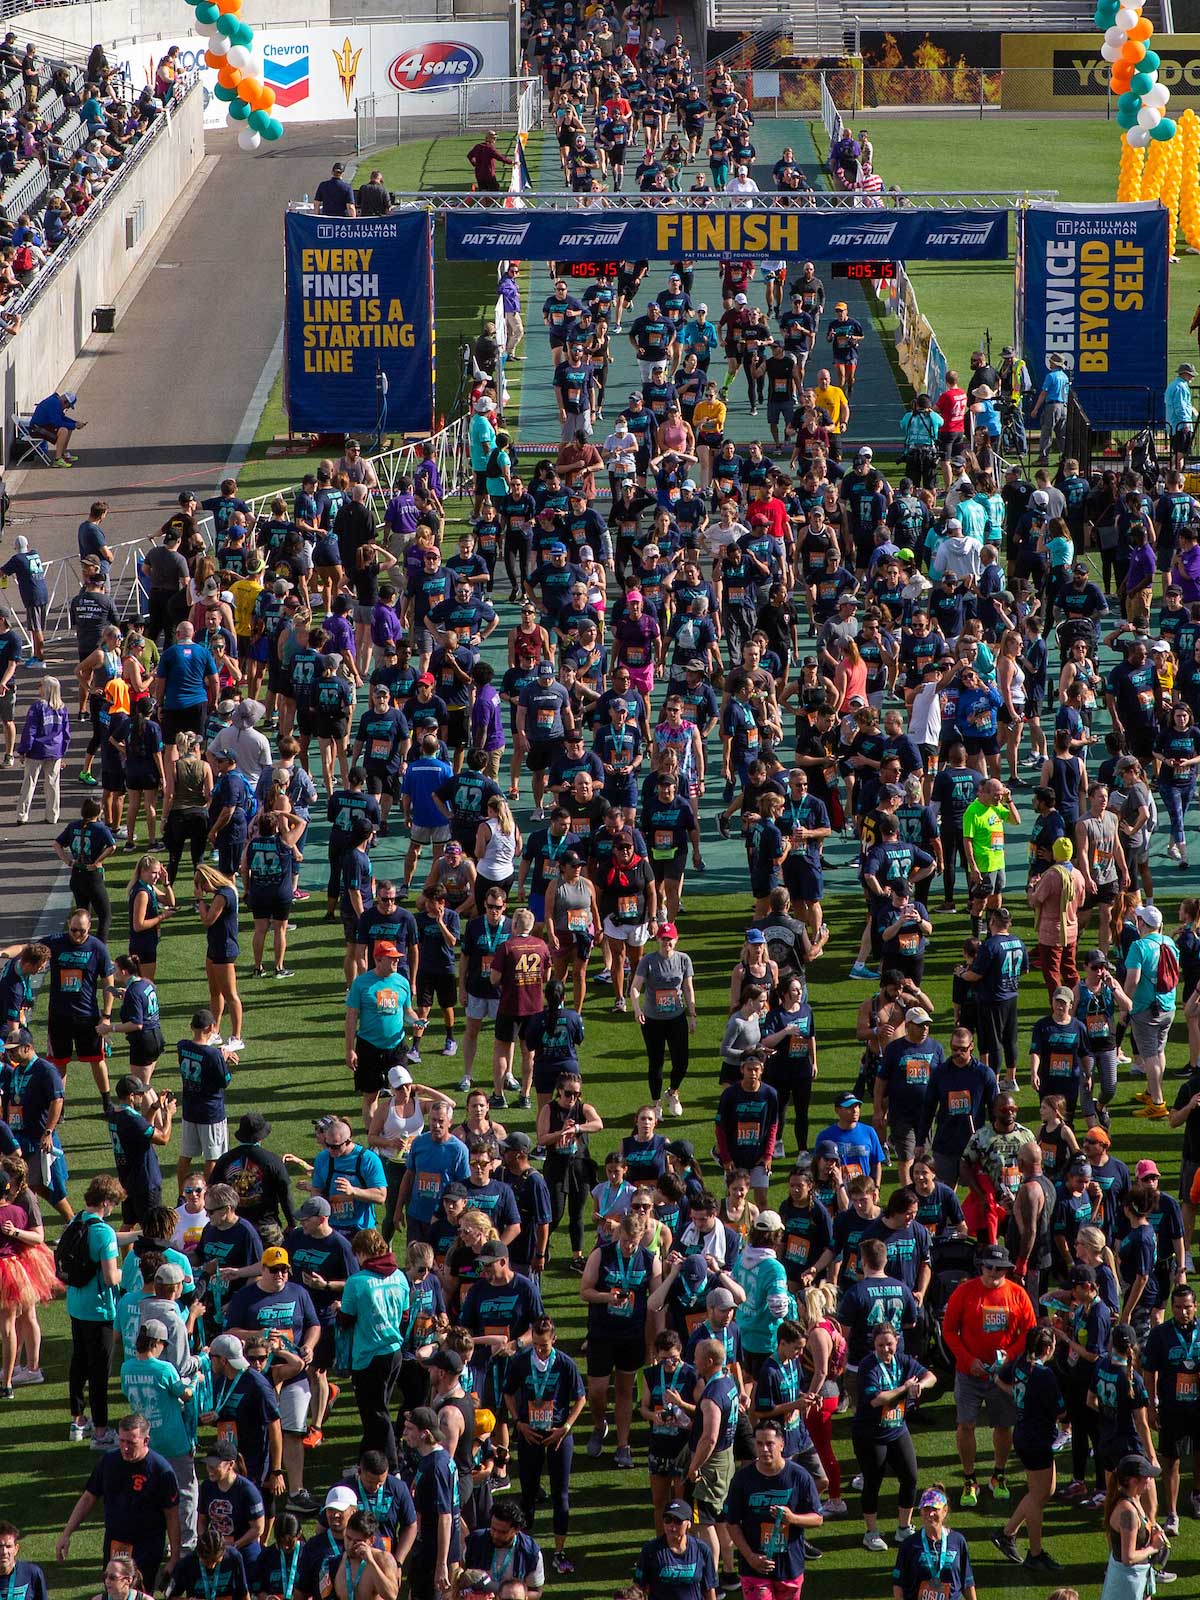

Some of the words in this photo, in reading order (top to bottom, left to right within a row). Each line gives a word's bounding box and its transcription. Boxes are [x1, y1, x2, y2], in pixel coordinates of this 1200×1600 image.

[264, 44, 309, 56] Chevron
[398, 54, 424, 80] 4
[422, 61, 469, 75] SONS
[461, 234, 494, 245] PAT'S
[498, 233, 525, 246] RUN
[559, 234, 592, 246] PAT'S
[596, 233, 622, 246] RUN
[656, 214, 798, 251] FINISH
[829, 234, 861, 246] PAT'S
[865, 233, 890, 245] RUN
[926, 234, 958, 245] PAT'S
[961, 233, 988, 244] RUN
[302, 249, 373, 272] EVERY
[303, 274, 379, 297] FINISH
[1114, 240, 1144, 311] SELF
[304, 300, 353, 322] LINE
[360, 300, 382, 322] IS
[388, 299, 404, 321] A
[1080, 240, 1110, 372] BEYOND
[303, 324, 415, 348] STARTING
[304, 350, 354, 373] LINE
[30, 559, 44, 573] 42
[1180, 634, 1194, 649] 42
[293, 662, 314, 684] 42
[319, 690, 338, 705] 42
[455, 786, 482, 812] 42
[952, 782, 974, 801] 42
[251, 852, 282, 875] 42
[887, 859, 914, 880] 42
[516, 953, 541, 972] 42
[1001, 949, 1023, 977] 42
[180, 1058, 201, 1082] 42
[909, 1068, 927, 1077] 2133
[867, 1299, 904, 1325] 42
[986, 1313, 1006, 1325] 5565
[125, 1375, 154, 1384] TILLMAN
[530, 1410, 553, 1422] 16302
[209, 1499, 233, 1535] S
